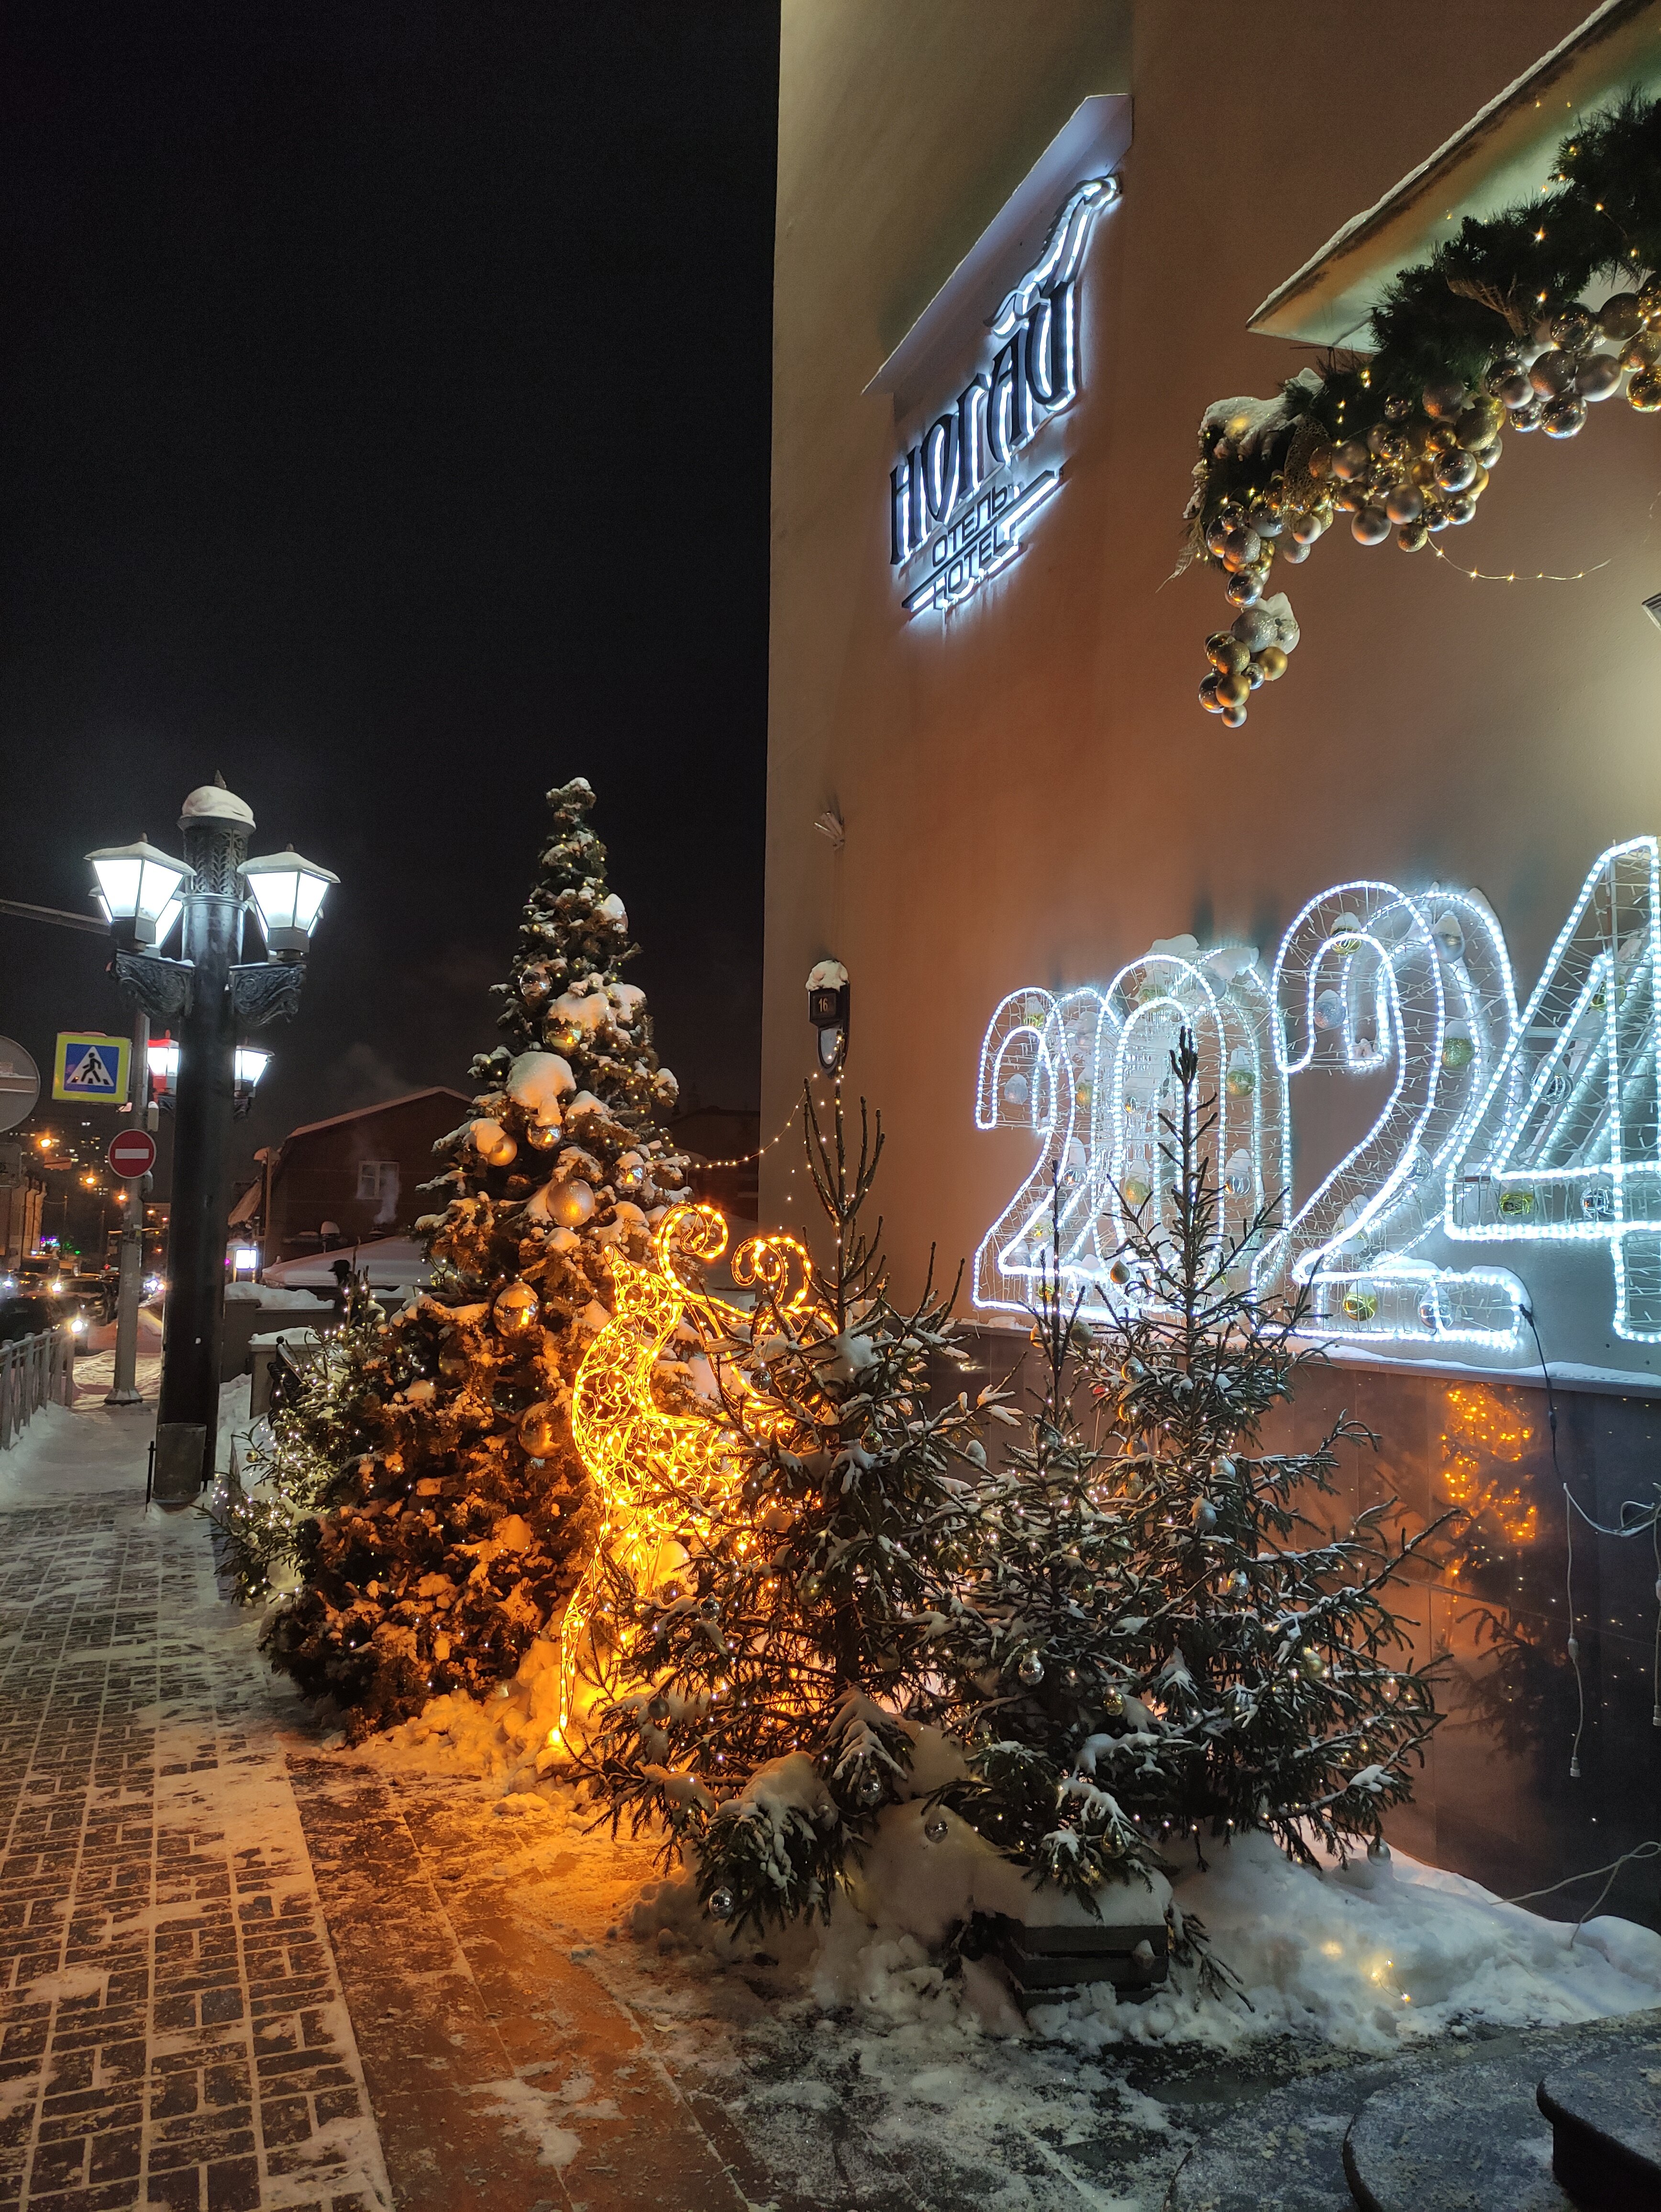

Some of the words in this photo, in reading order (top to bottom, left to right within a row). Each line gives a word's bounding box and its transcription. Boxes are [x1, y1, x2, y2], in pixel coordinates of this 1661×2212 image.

[933, 486, 1008, 567] ОТЕЛЬ
[933, 524, 1008, 610] HOTEL
[974, 834, 1661, 1351] 2024
